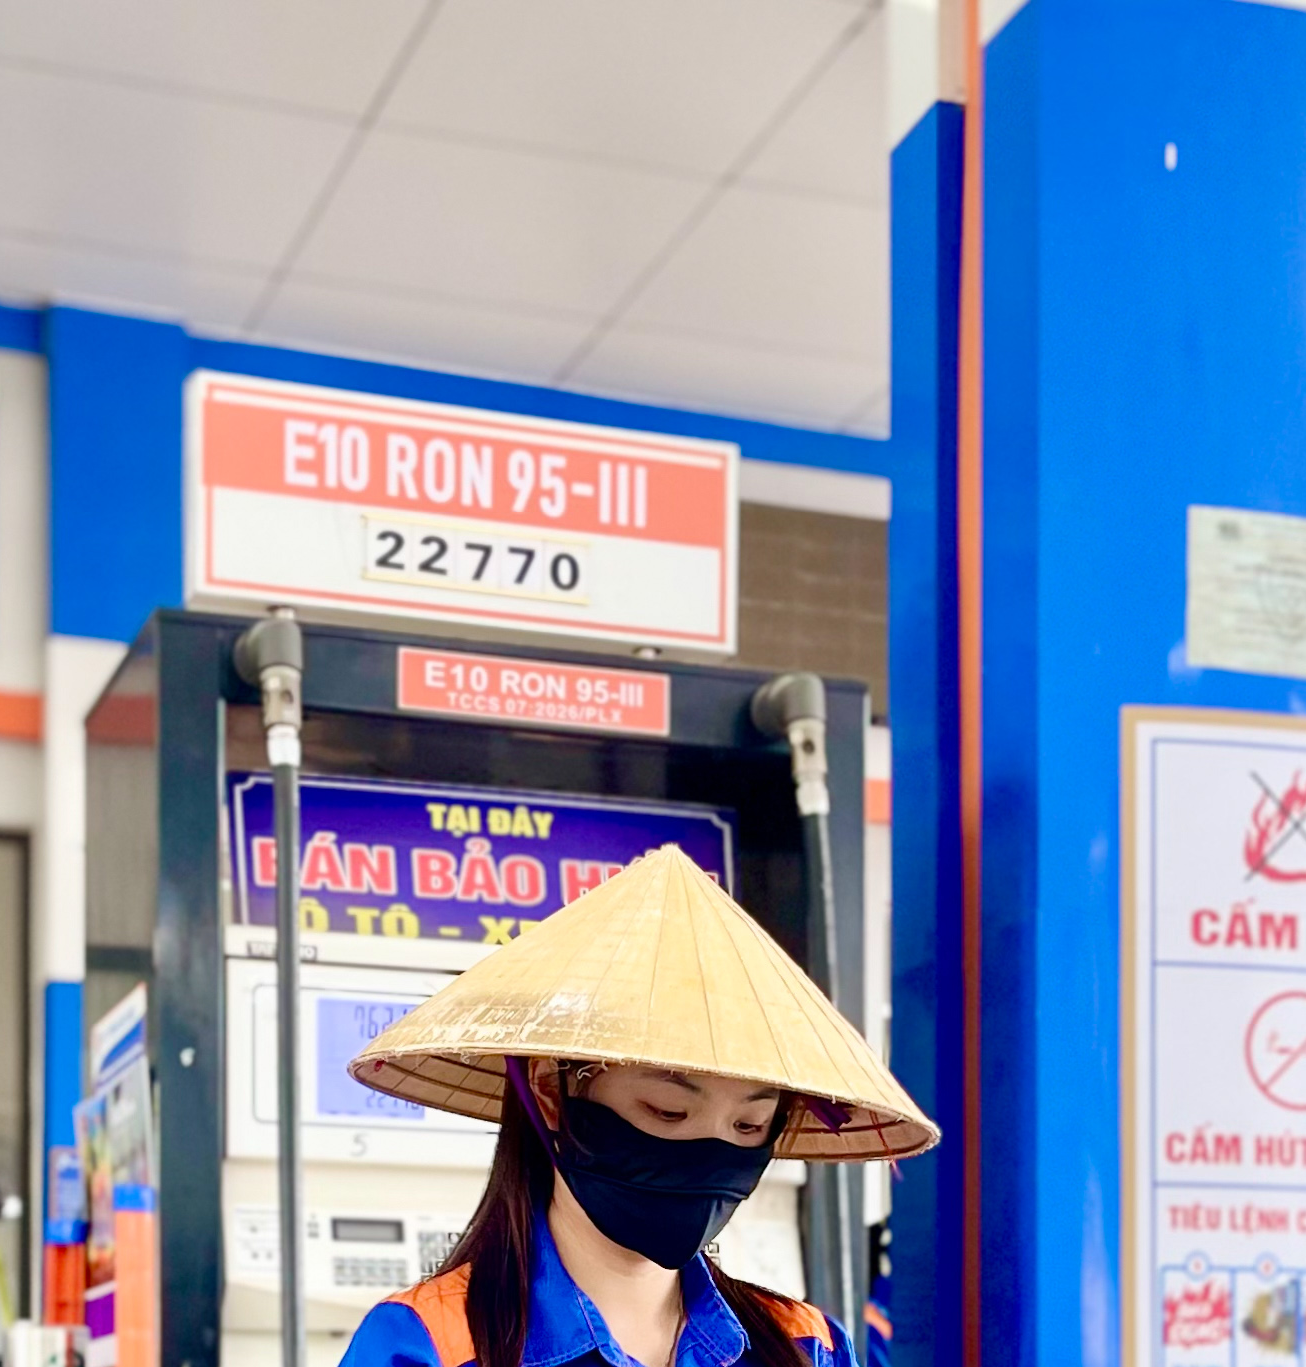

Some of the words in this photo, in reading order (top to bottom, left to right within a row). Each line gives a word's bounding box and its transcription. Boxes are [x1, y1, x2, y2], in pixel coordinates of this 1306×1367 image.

[283, 419, 370, 493] E10
[385, 432, 494, 510] RON
[507, 449, 648, 529] 95-III
[374, 529, 581, 592] 22770
[423, 660, 489, 693] E10
[499, 668, 567, 700] RON
[575, 676, 645, 708] 95-III
[446, 691, 500, 713] TCCS
[426, 803, 481, 838] TẠI
[487, 804, 554, 839] ĐÂY
[411, 837, 546, 907] BẢO
[346, 903, 420, 939] TÔ
[1189, 897, 1298, 948] CẤM
[1165, 1121, 1242, 1166] CẤM
